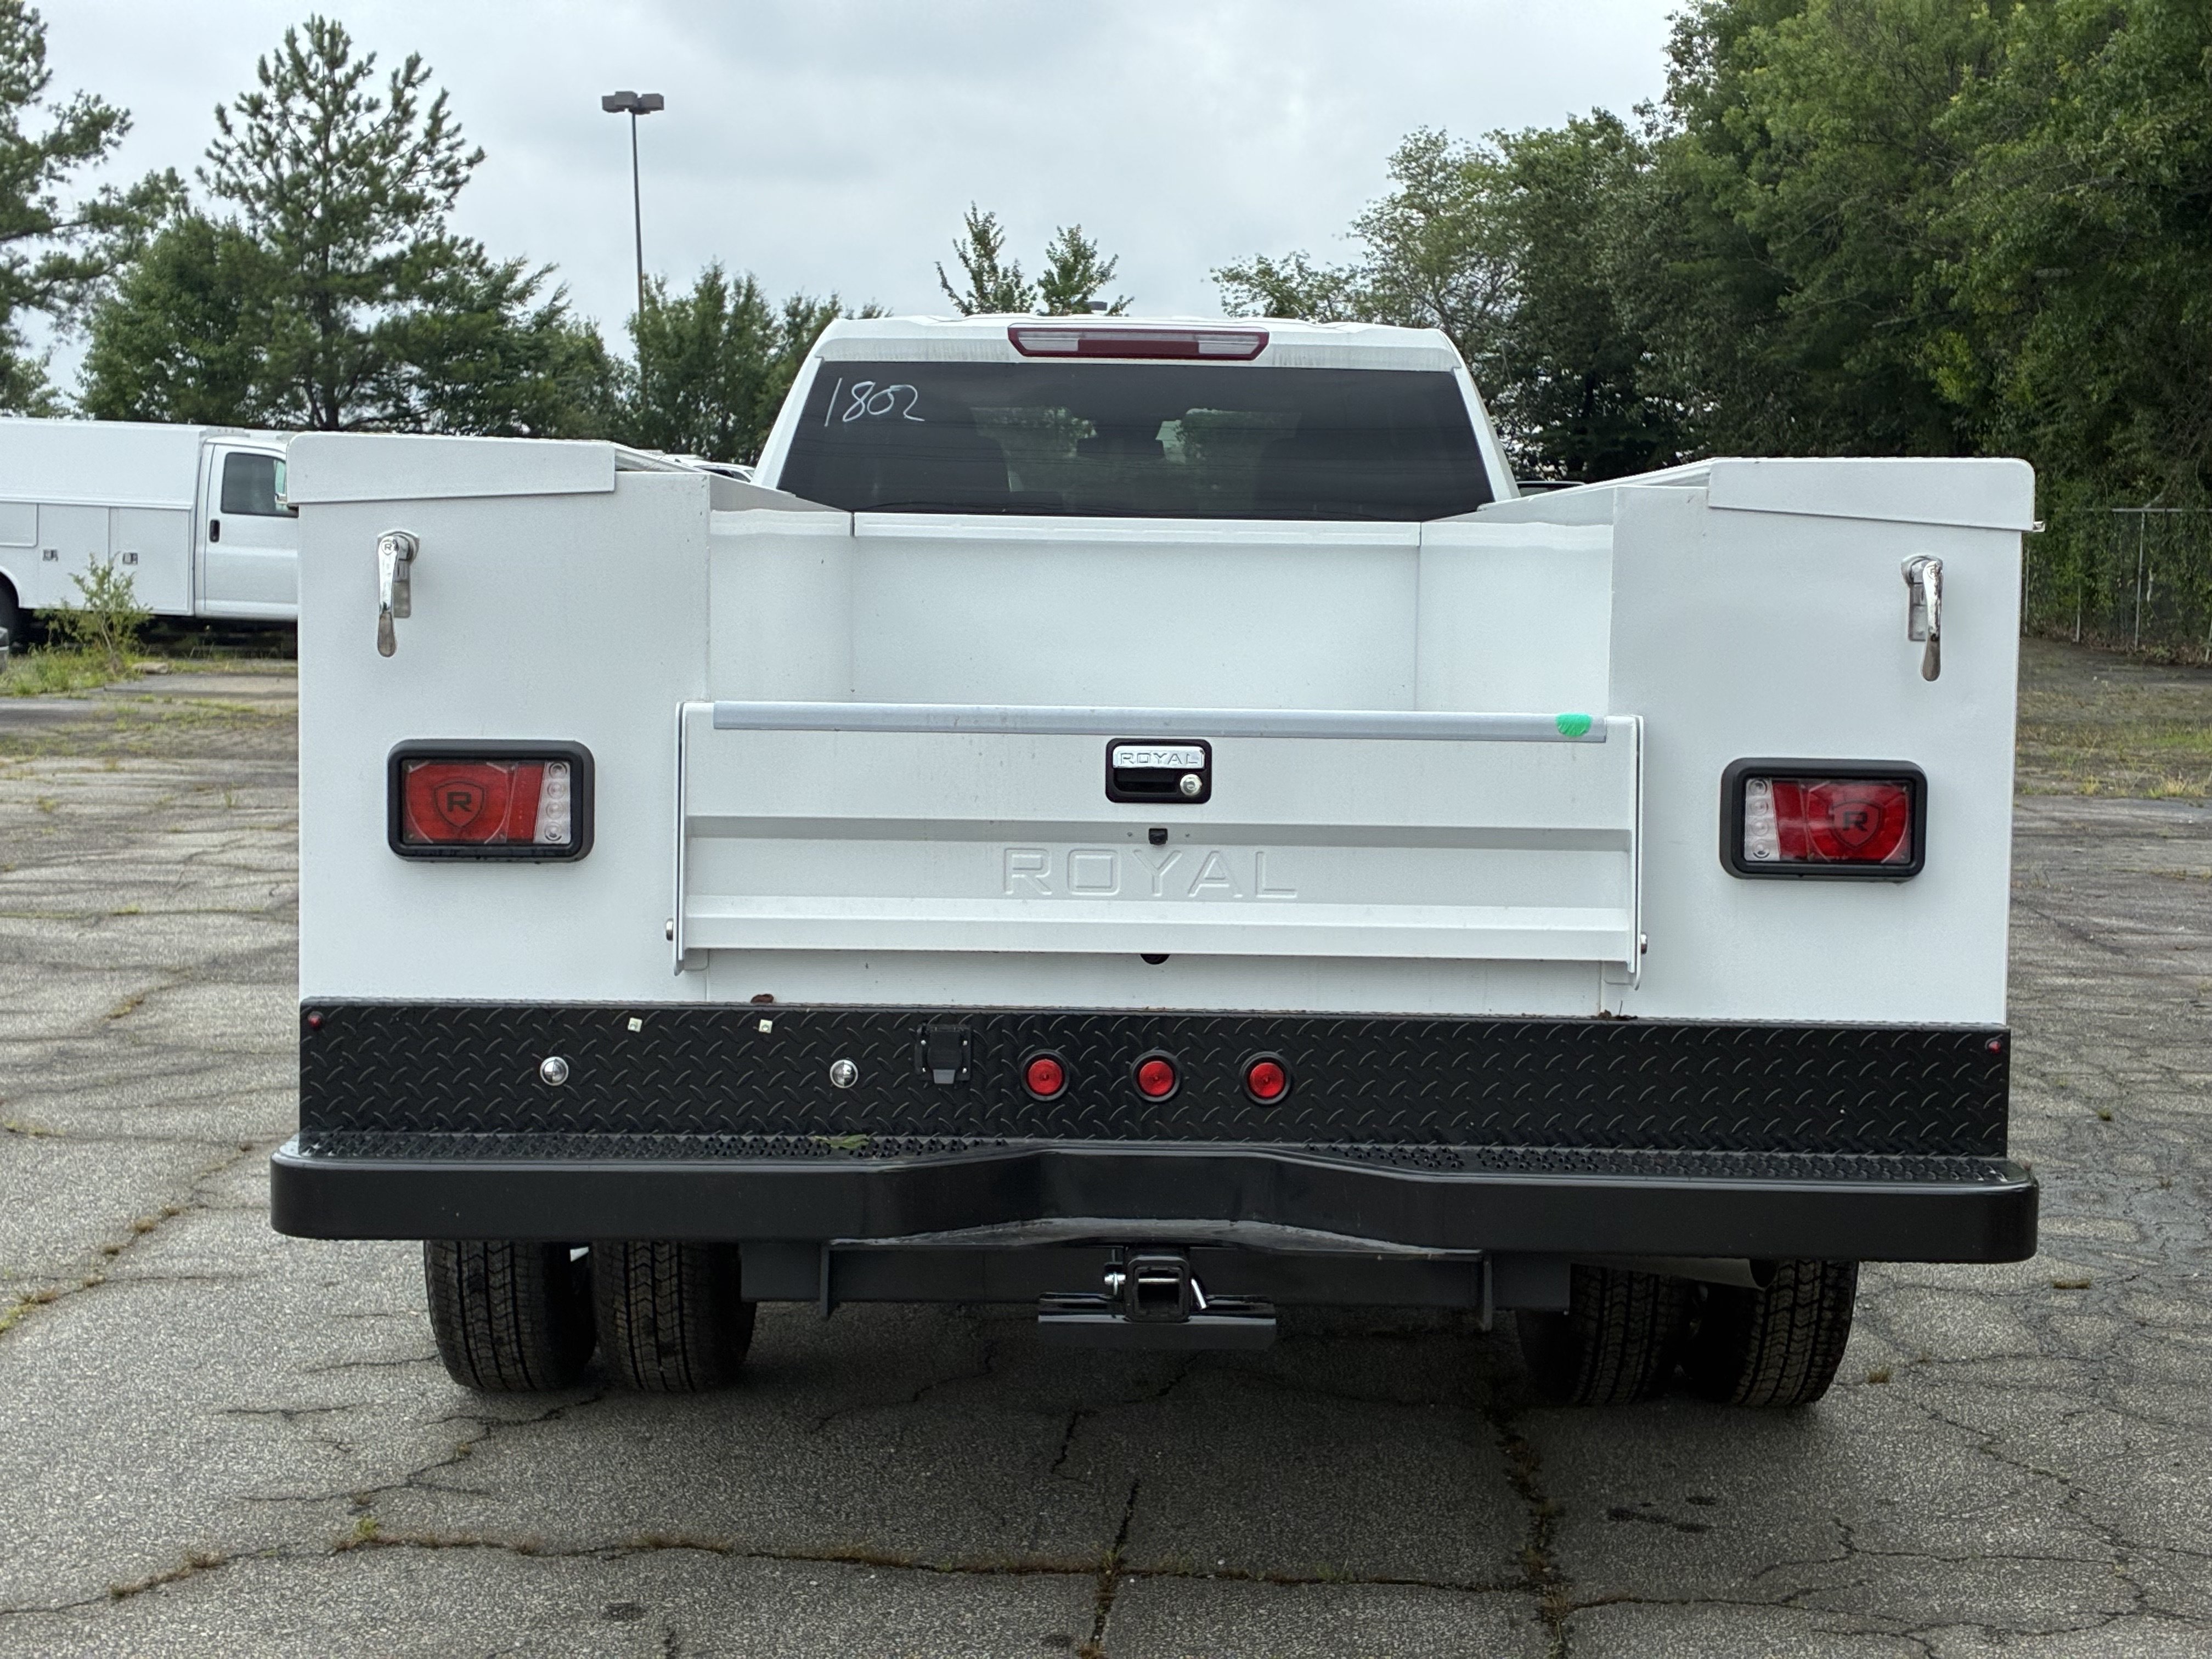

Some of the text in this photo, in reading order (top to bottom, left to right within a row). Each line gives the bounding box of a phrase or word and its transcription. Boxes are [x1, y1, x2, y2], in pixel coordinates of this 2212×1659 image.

[824, 377, 925, 427] 1802
[1120, 752, 1198, 765] ROYAL
[446, 791, 472, 812] R
[1842, 811, 1868, 832] R
[1003, 848, 1297, 899] ROYAL
